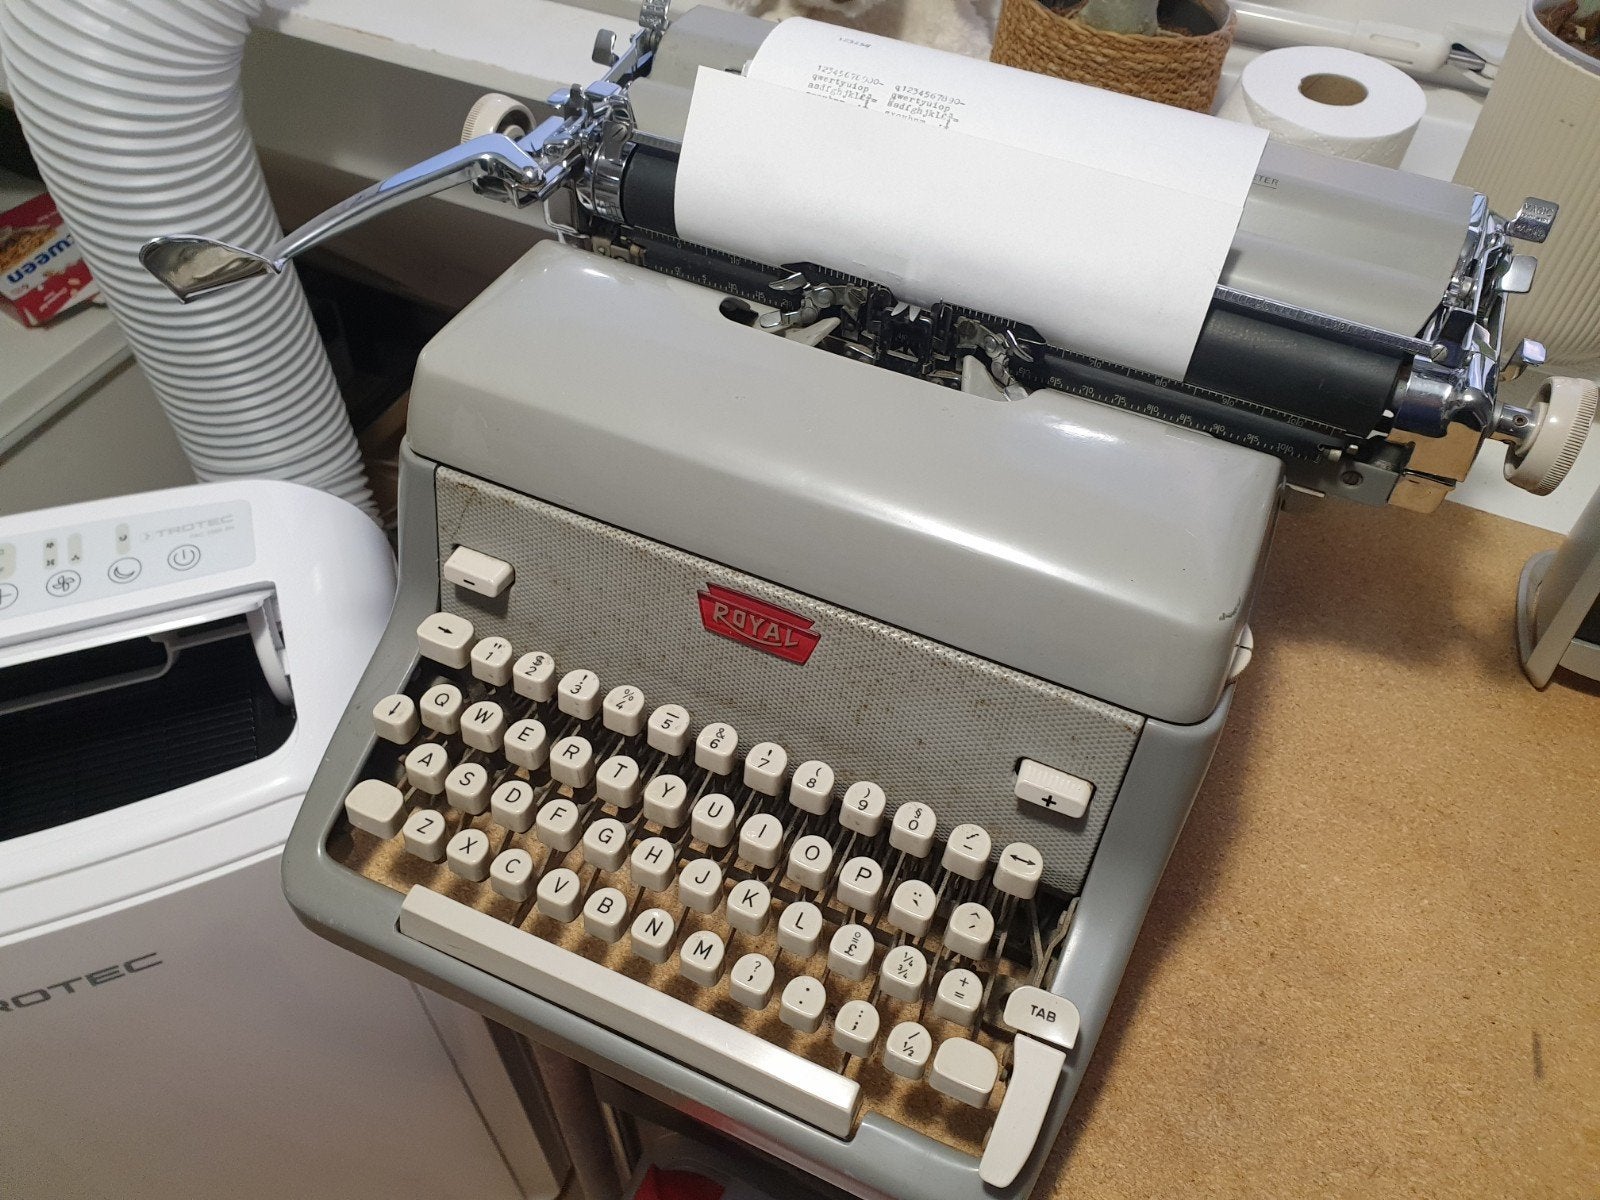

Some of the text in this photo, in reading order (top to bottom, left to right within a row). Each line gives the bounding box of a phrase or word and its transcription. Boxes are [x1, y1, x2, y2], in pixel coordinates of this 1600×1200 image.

[811, 73, 870, 93] qwertyuiop
[891, 92, 951, 113] qwertyuiop
[711, 601, 799, 648] ROYAL
[486, 652, 493, 660] 1
[525, 666, 537, 676] 2
[570, 684, 582, 694] 3
[435, 693, 449, 707] Q
[616, 701, 625, 709] 4
[475, 708, 493, 723] W
[661, 719, 673, 730] 5
[518, 727, 534, 741] E
[710, 739, 720, 748] 6
[563, 744, 580, 759] R
[418, 753, 433, 767] A
[758, 758, 770, 768] 7
[614, 763, 627, 778] T
[460, 772, 475, 785] S
[806, 778, 816, 788] 8
[505, 788, 521, 802] D
[662, 783, 675, 797] Y
[708, 802, 723, 817] U
[858, 800, 868, 810] 9
[550, 807, 566, 820] F
[417, 818, 433, 834] Z
[759, 824, 767, 838] I
[909, 820, 918, 830] 0
[599, 828, 613, 844] G
[459, 837, 478, 854] X
[645, 846, 663, 863] H
[805, 846, 820, 860] O
[506, 859, 520, 873] C
[695, 871, 710, 884] J
[855, 867, 872, 881] P
[555, 877, 569, 893] V
[597, 897, 613, 913] B
[742, 889, 759, 907] K
[645, 918, 663, 936] N
[795, 912, 803, 929] L
[693, 940, 713, 959] M
[1031, 1005, 1056, 1022] TAB
